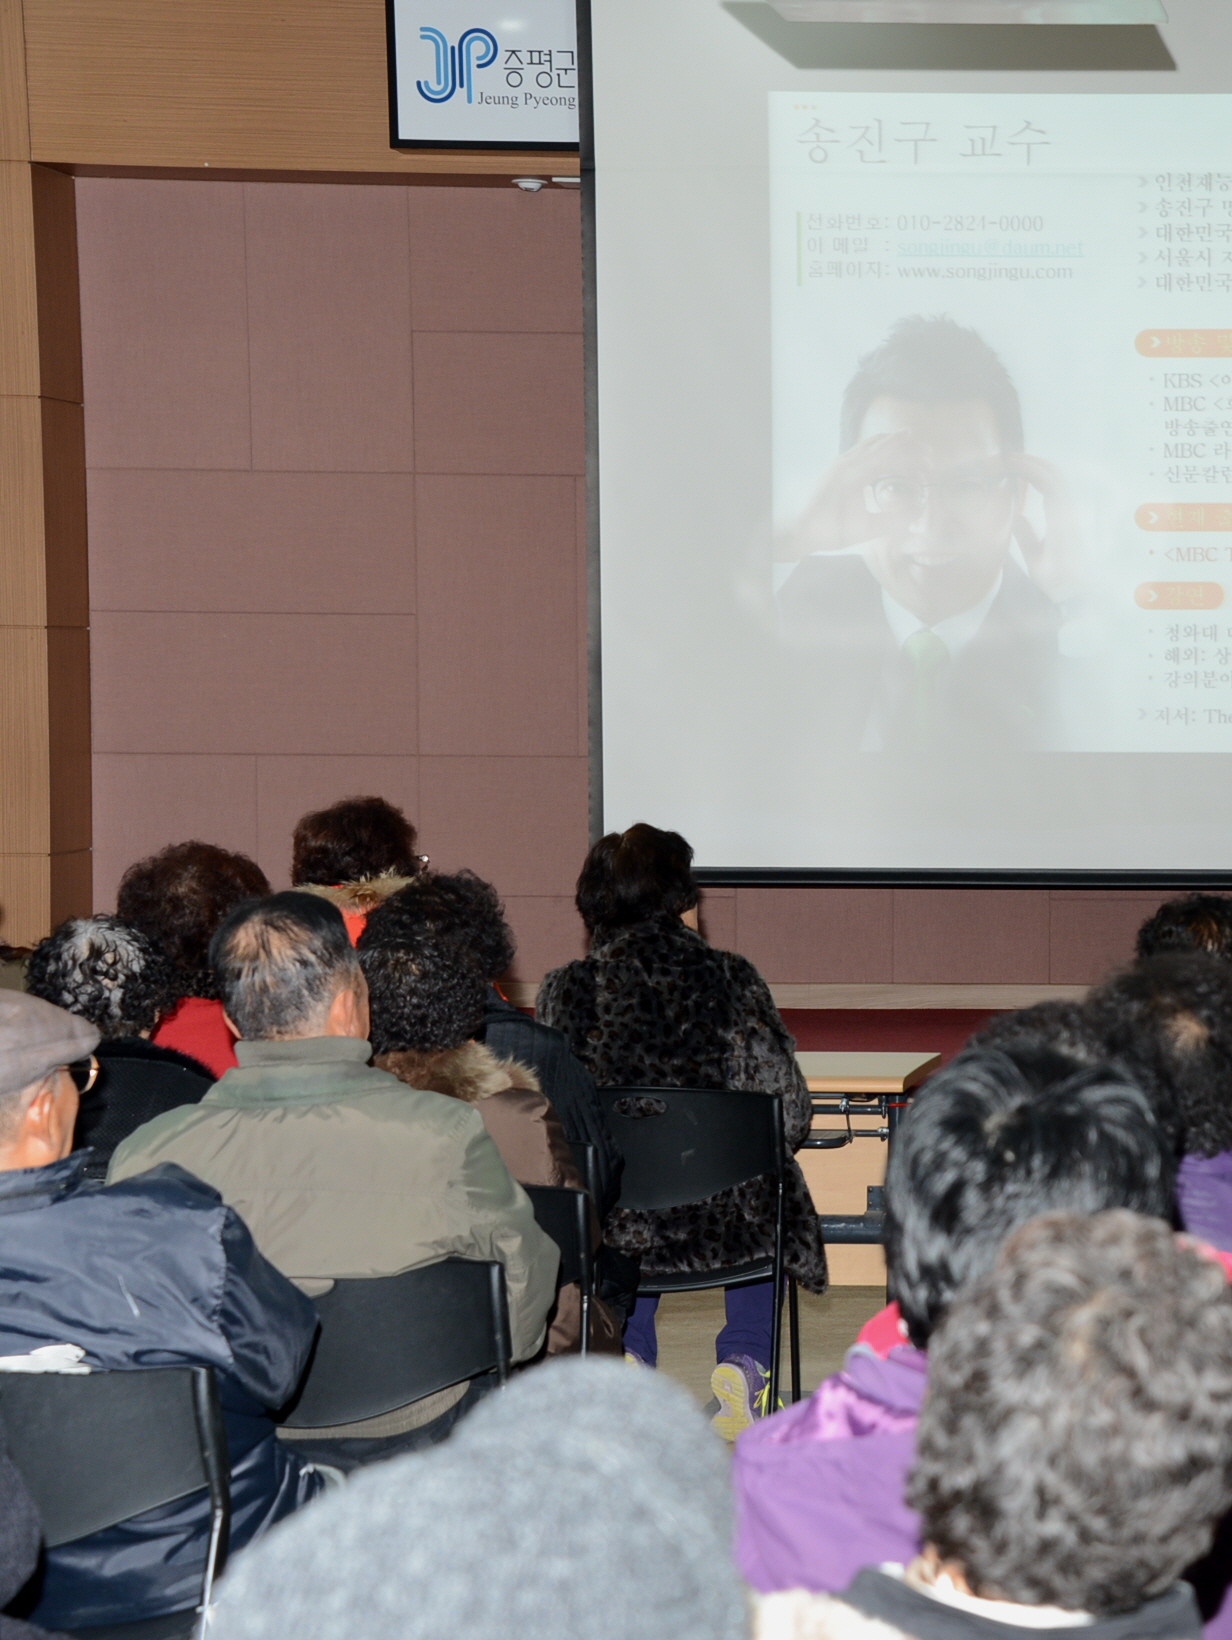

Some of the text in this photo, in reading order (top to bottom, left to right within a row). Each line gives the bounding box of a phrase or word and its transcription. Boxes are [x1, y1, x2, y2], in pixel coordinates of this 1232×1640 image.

[503, 49, 576, 89] 증평군
[477, 92, 577, 110] Jeung Pyeong
[796, 117, 1051, 166] 송진구 교수
[1155, 197, 1213, 218] 송진구
[897, 214, 1044, 232] 010-2824-0000
[1155, 247, 1212, 268] 서울시
[808, 260, 1073, 281] 홈페이지: www.songjingu.com
[1167, 333, 1207, 354] 방송
[1163, 373, 1203, 389] KBS
[1163, 396, 1206, 412] MBC
[1163, 443, 1206, 459] MBC
[1164, 546, 1218, 563] <MBC
[1166, 585, 1204, 606] 강연
[1165, 624, 1218, 642] 청와대
[1164, 647, 1206, 665] 해외:
